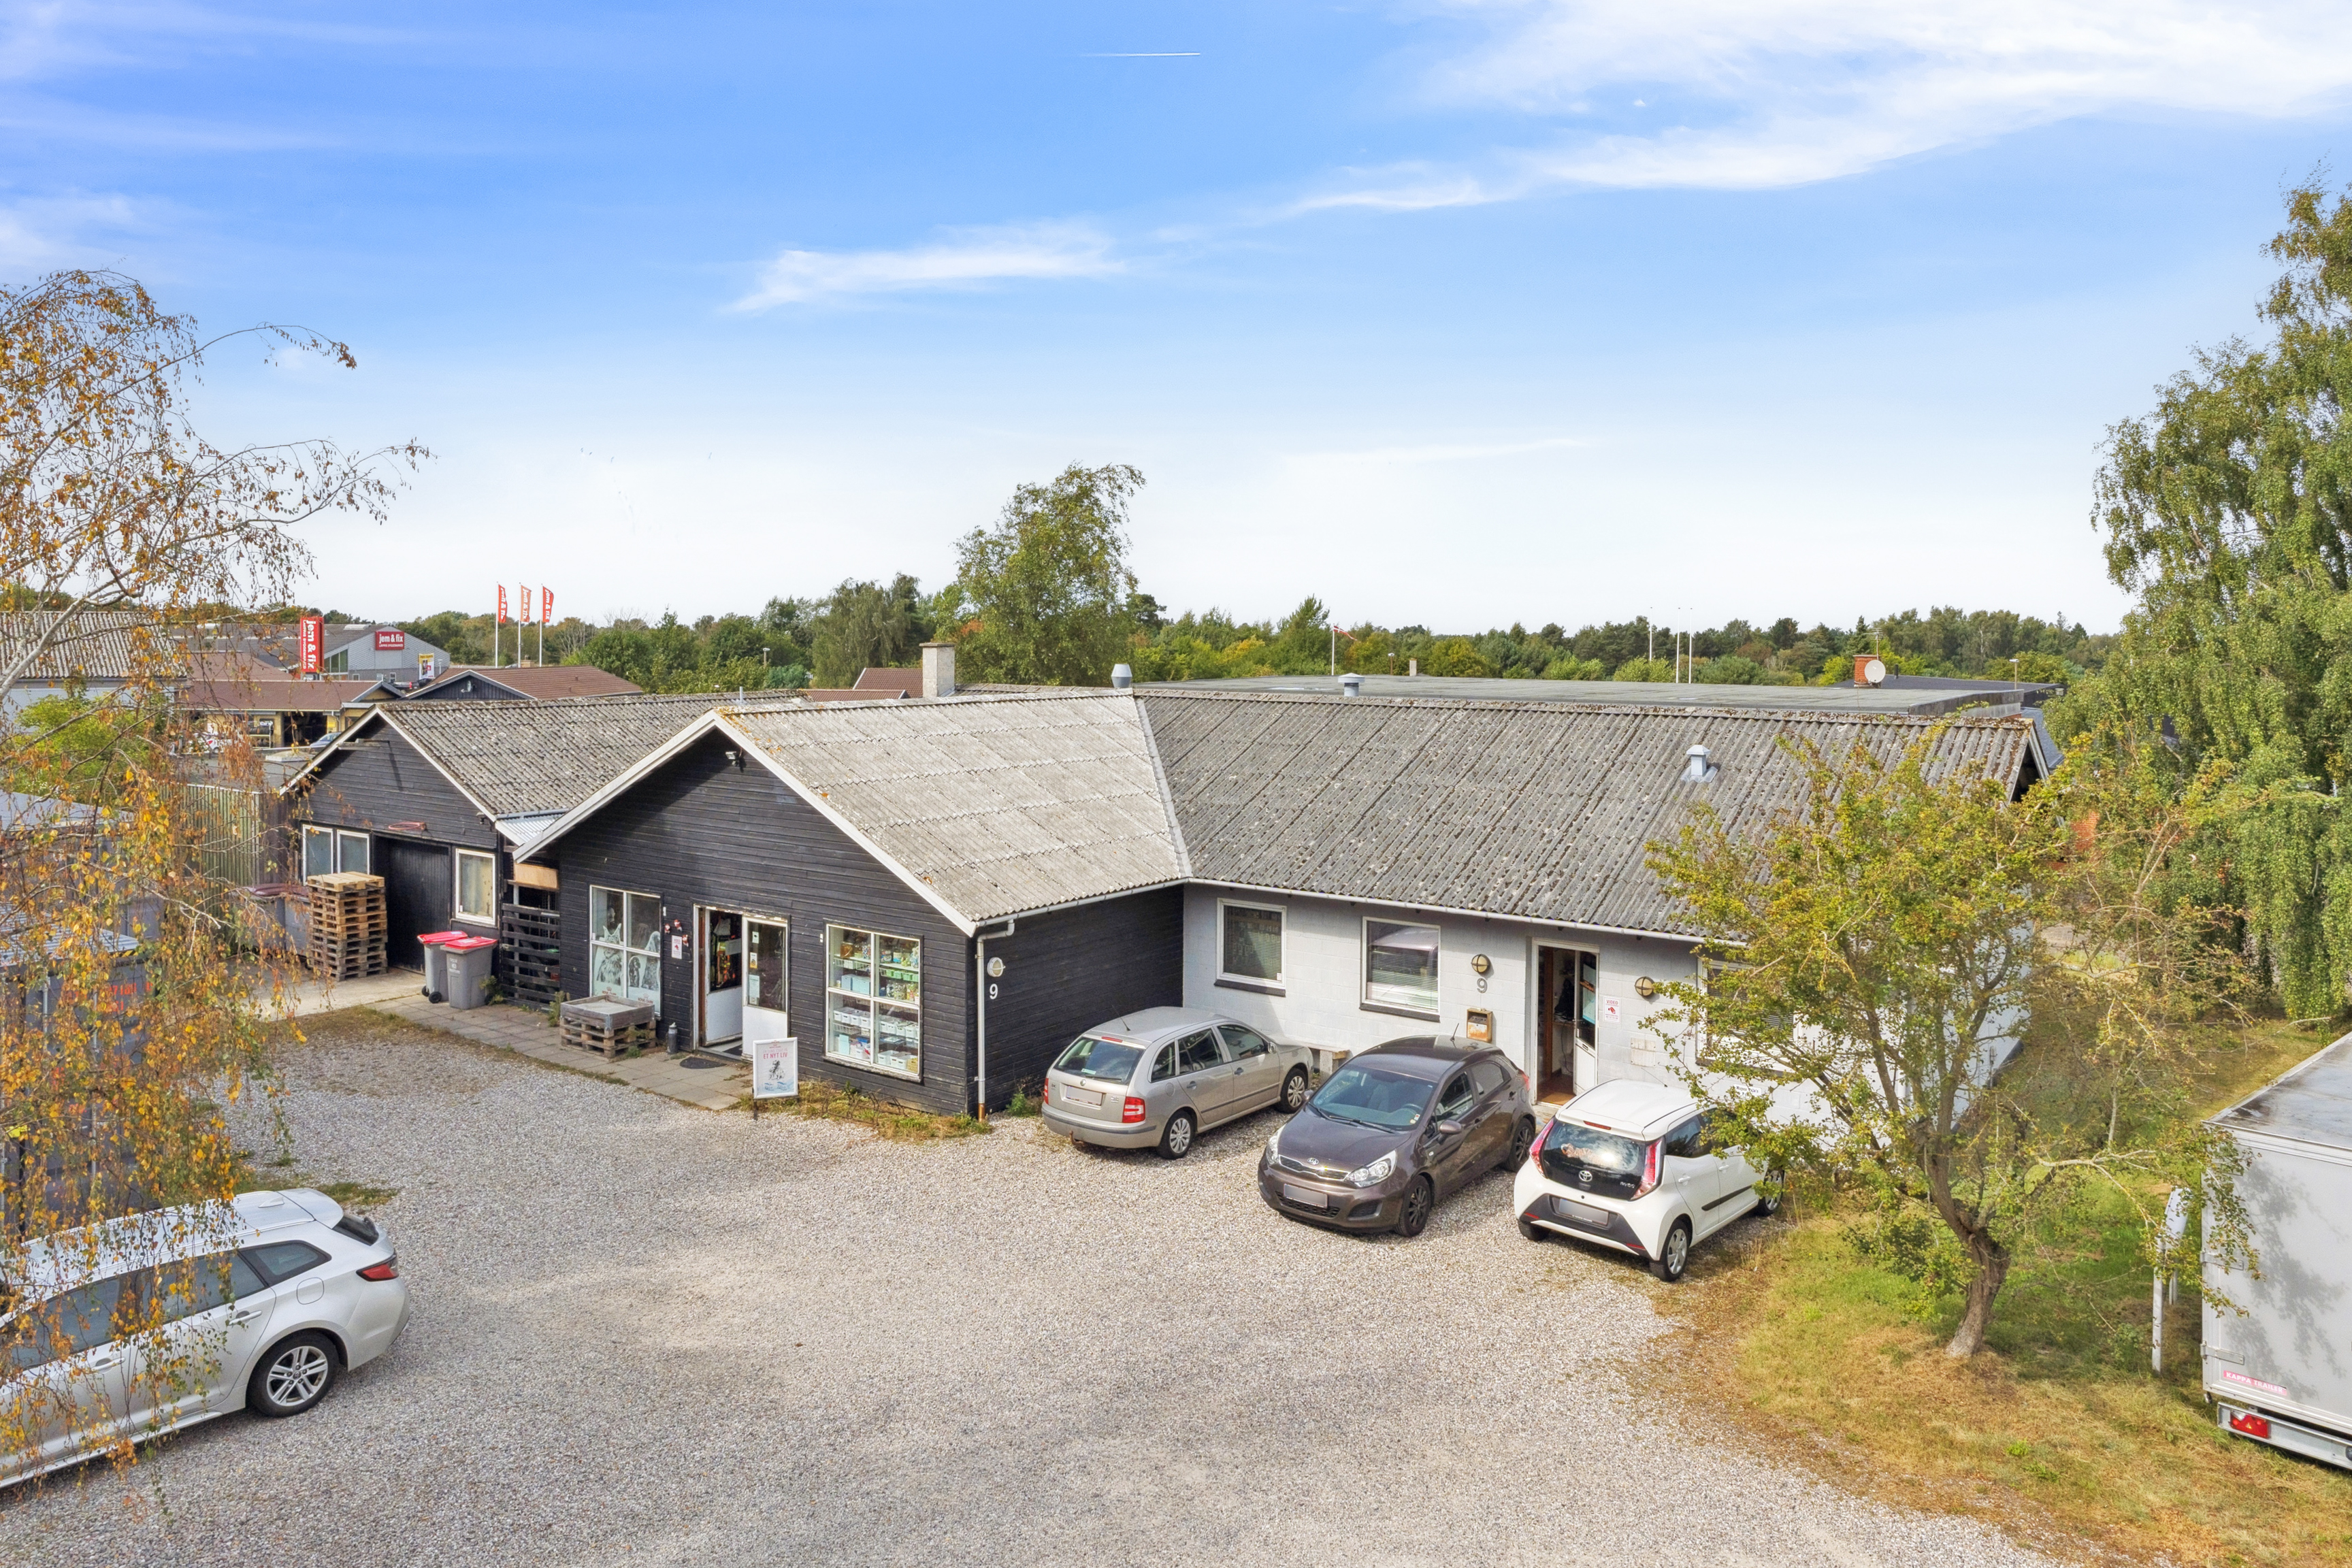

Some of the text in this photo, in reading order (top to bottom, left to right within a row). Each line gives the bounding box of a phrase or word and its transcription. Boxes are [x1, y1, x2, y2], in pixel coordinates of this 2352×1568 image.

[306, 620, 316, 670] jem & fix
[379, 634, 404, 644] jem & fix
[989, 983, 998, 1000] 9
[1476, 977, 1488, 994] 9
[2225, 1372, 2283, 1393] KAPPA TRAILER
